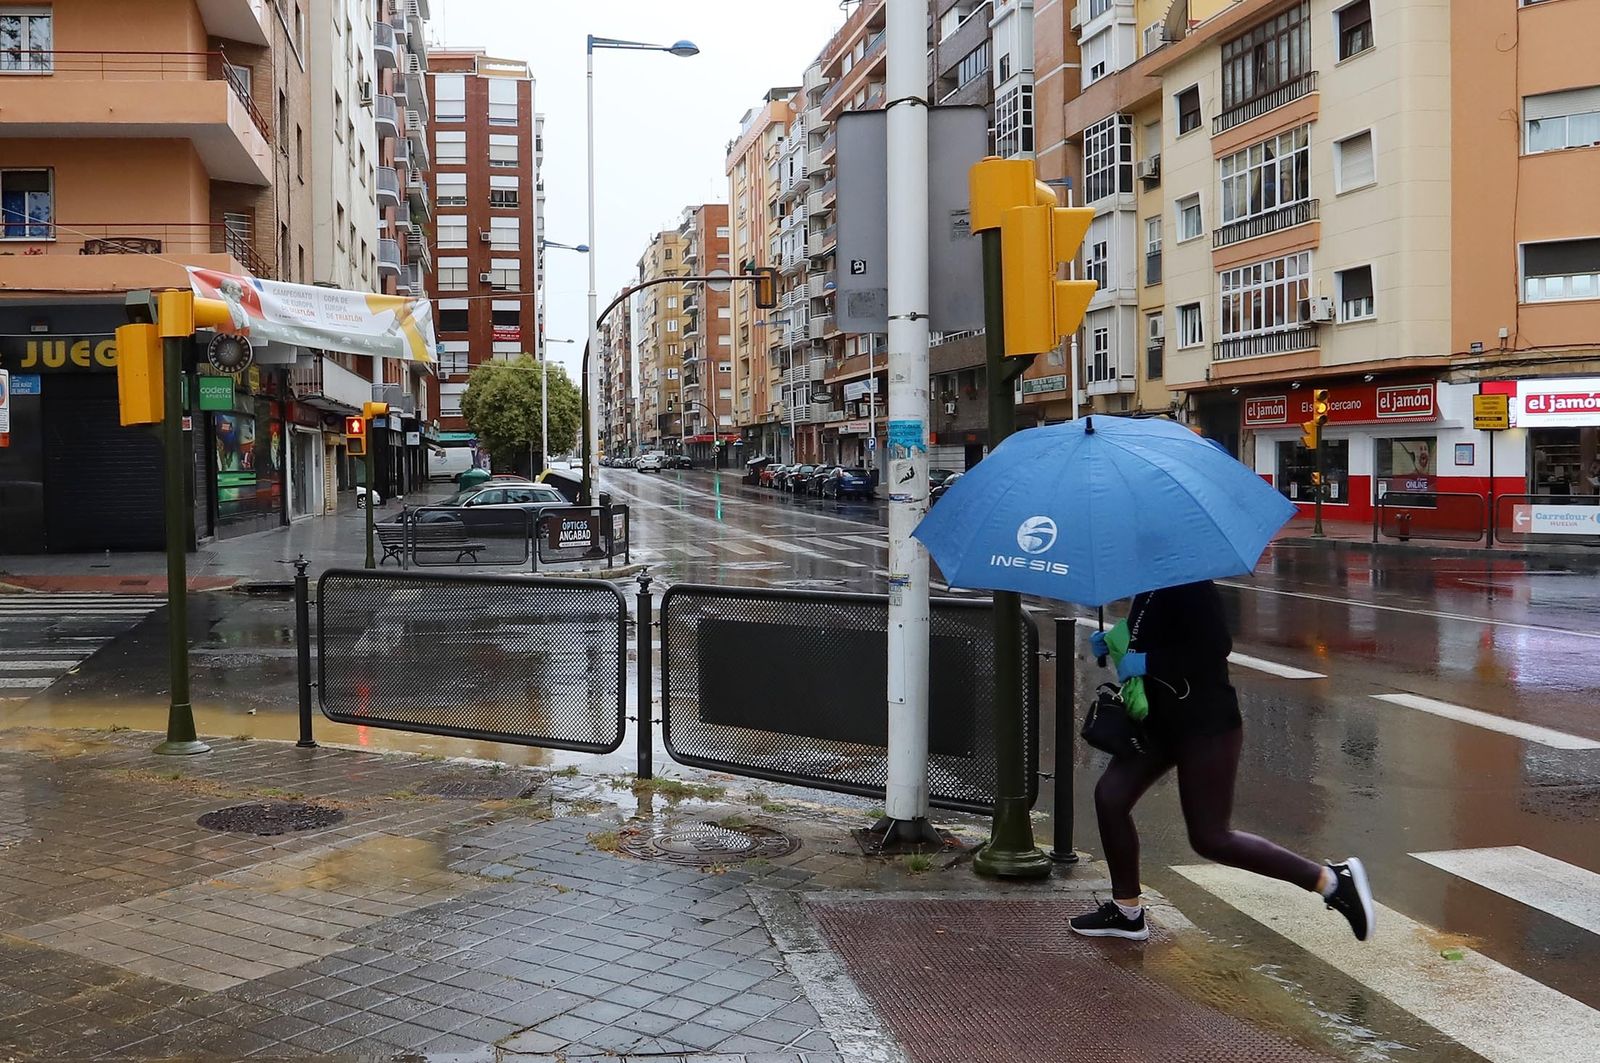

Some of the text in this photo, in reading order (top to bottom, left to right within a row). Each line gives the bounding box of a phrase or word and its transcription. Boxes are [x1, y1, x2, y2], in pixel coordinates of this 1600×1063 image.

[323, 295, 348, 305] COPA DE
[200, 386, 232, 394] codere
[1380, 388, 1430, 413] el jamón
[1528, 397, 1546, 410] el
[1248, 400, 1284, 418] el jamón
[1301, 402, 1308, 413] El
[1330, 400, 1362, 411] cercano
[868, 439, 875, 449] P
[1406, 481, 1428, 489] ONLINE
[1535, 512, 1588, 520] Carrefour
[559, 530, 591, 541] ANGABAD
